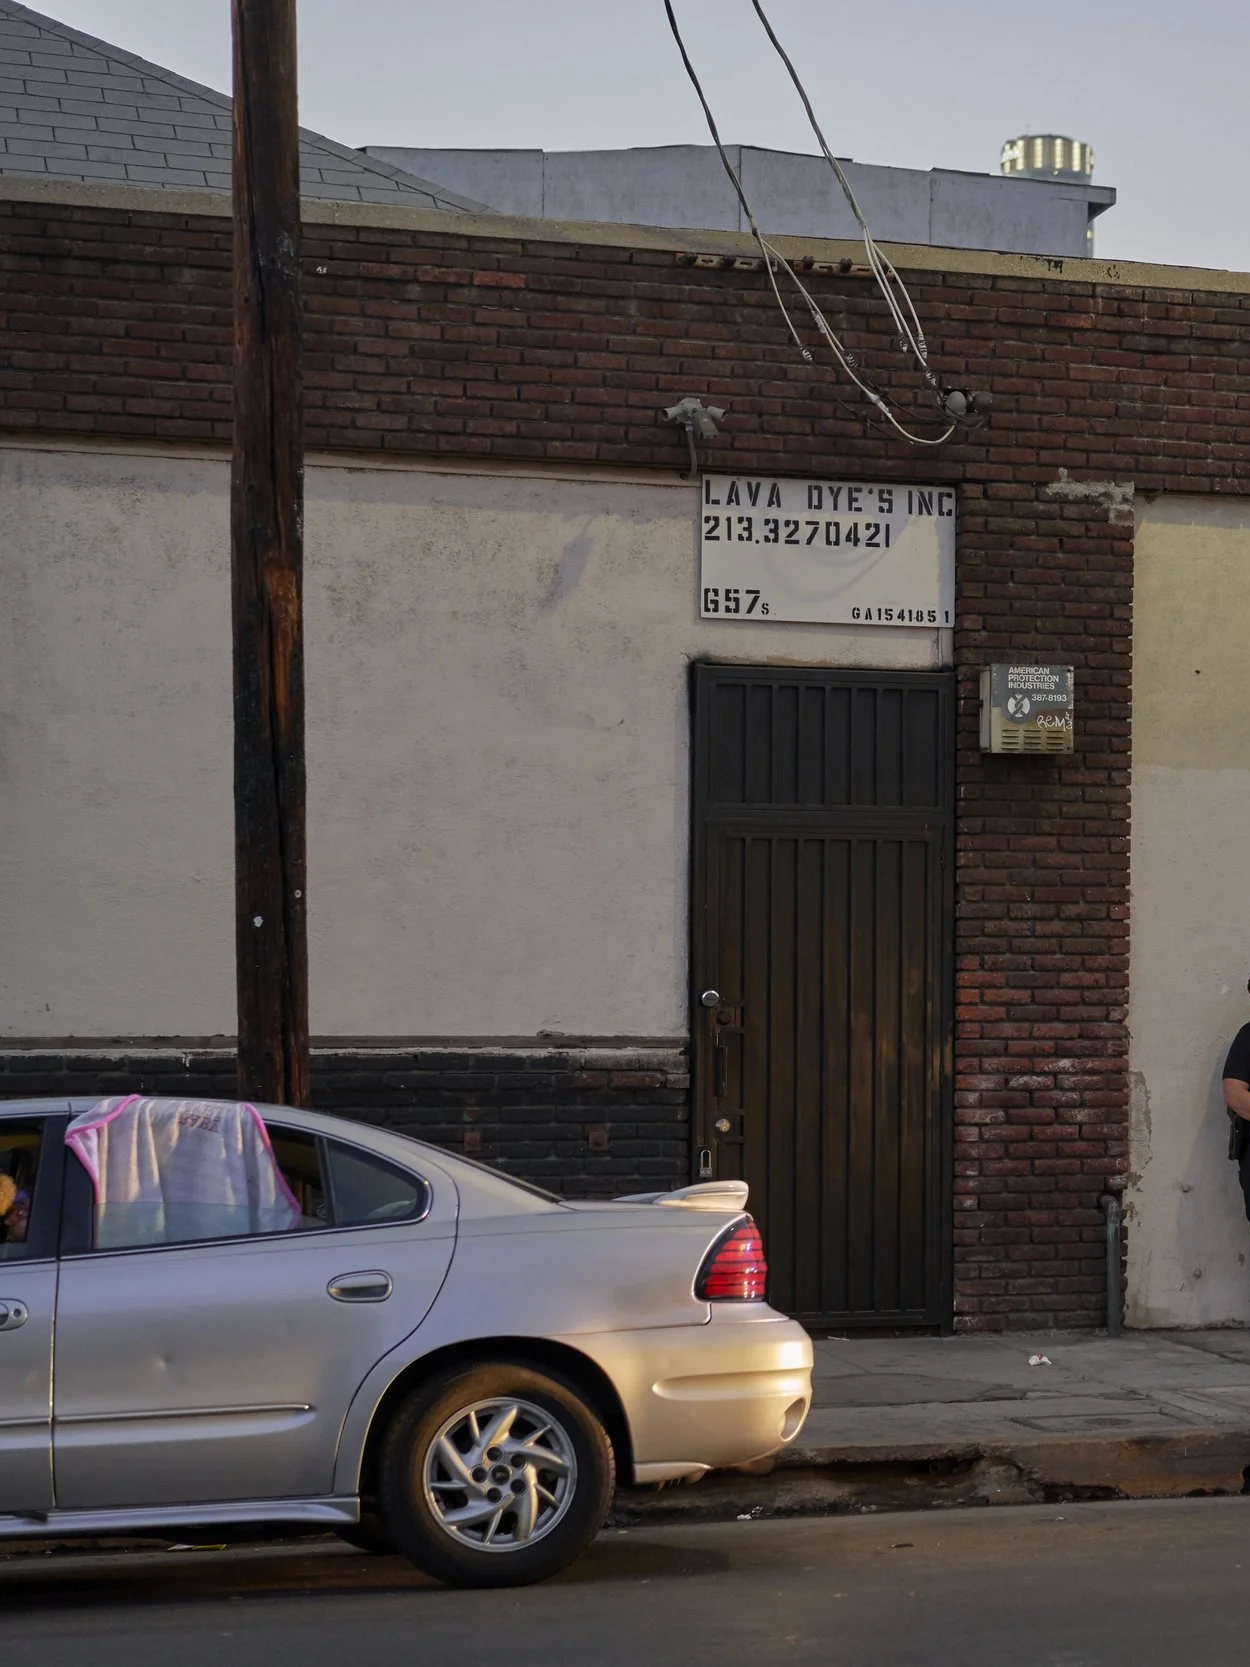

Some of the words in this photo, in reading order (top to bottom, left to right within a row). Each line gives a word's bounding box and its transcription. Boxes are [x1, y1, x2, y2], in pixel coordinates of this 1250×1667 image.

[704, 479, 782, 508] LAVA
[807, 484, 894, 514] DYE'S
[907, 489, 953, 517] INC
[704, 515, 890, 548] 213.3270421
[1008, 666, 1050, 675] AMERICAN
[1008, 674, 1060, 683] PROTECTION
[1008, 682, 1056, 690] INDUSTRIES
[1031, 693, 1067, 702] 387-8193
